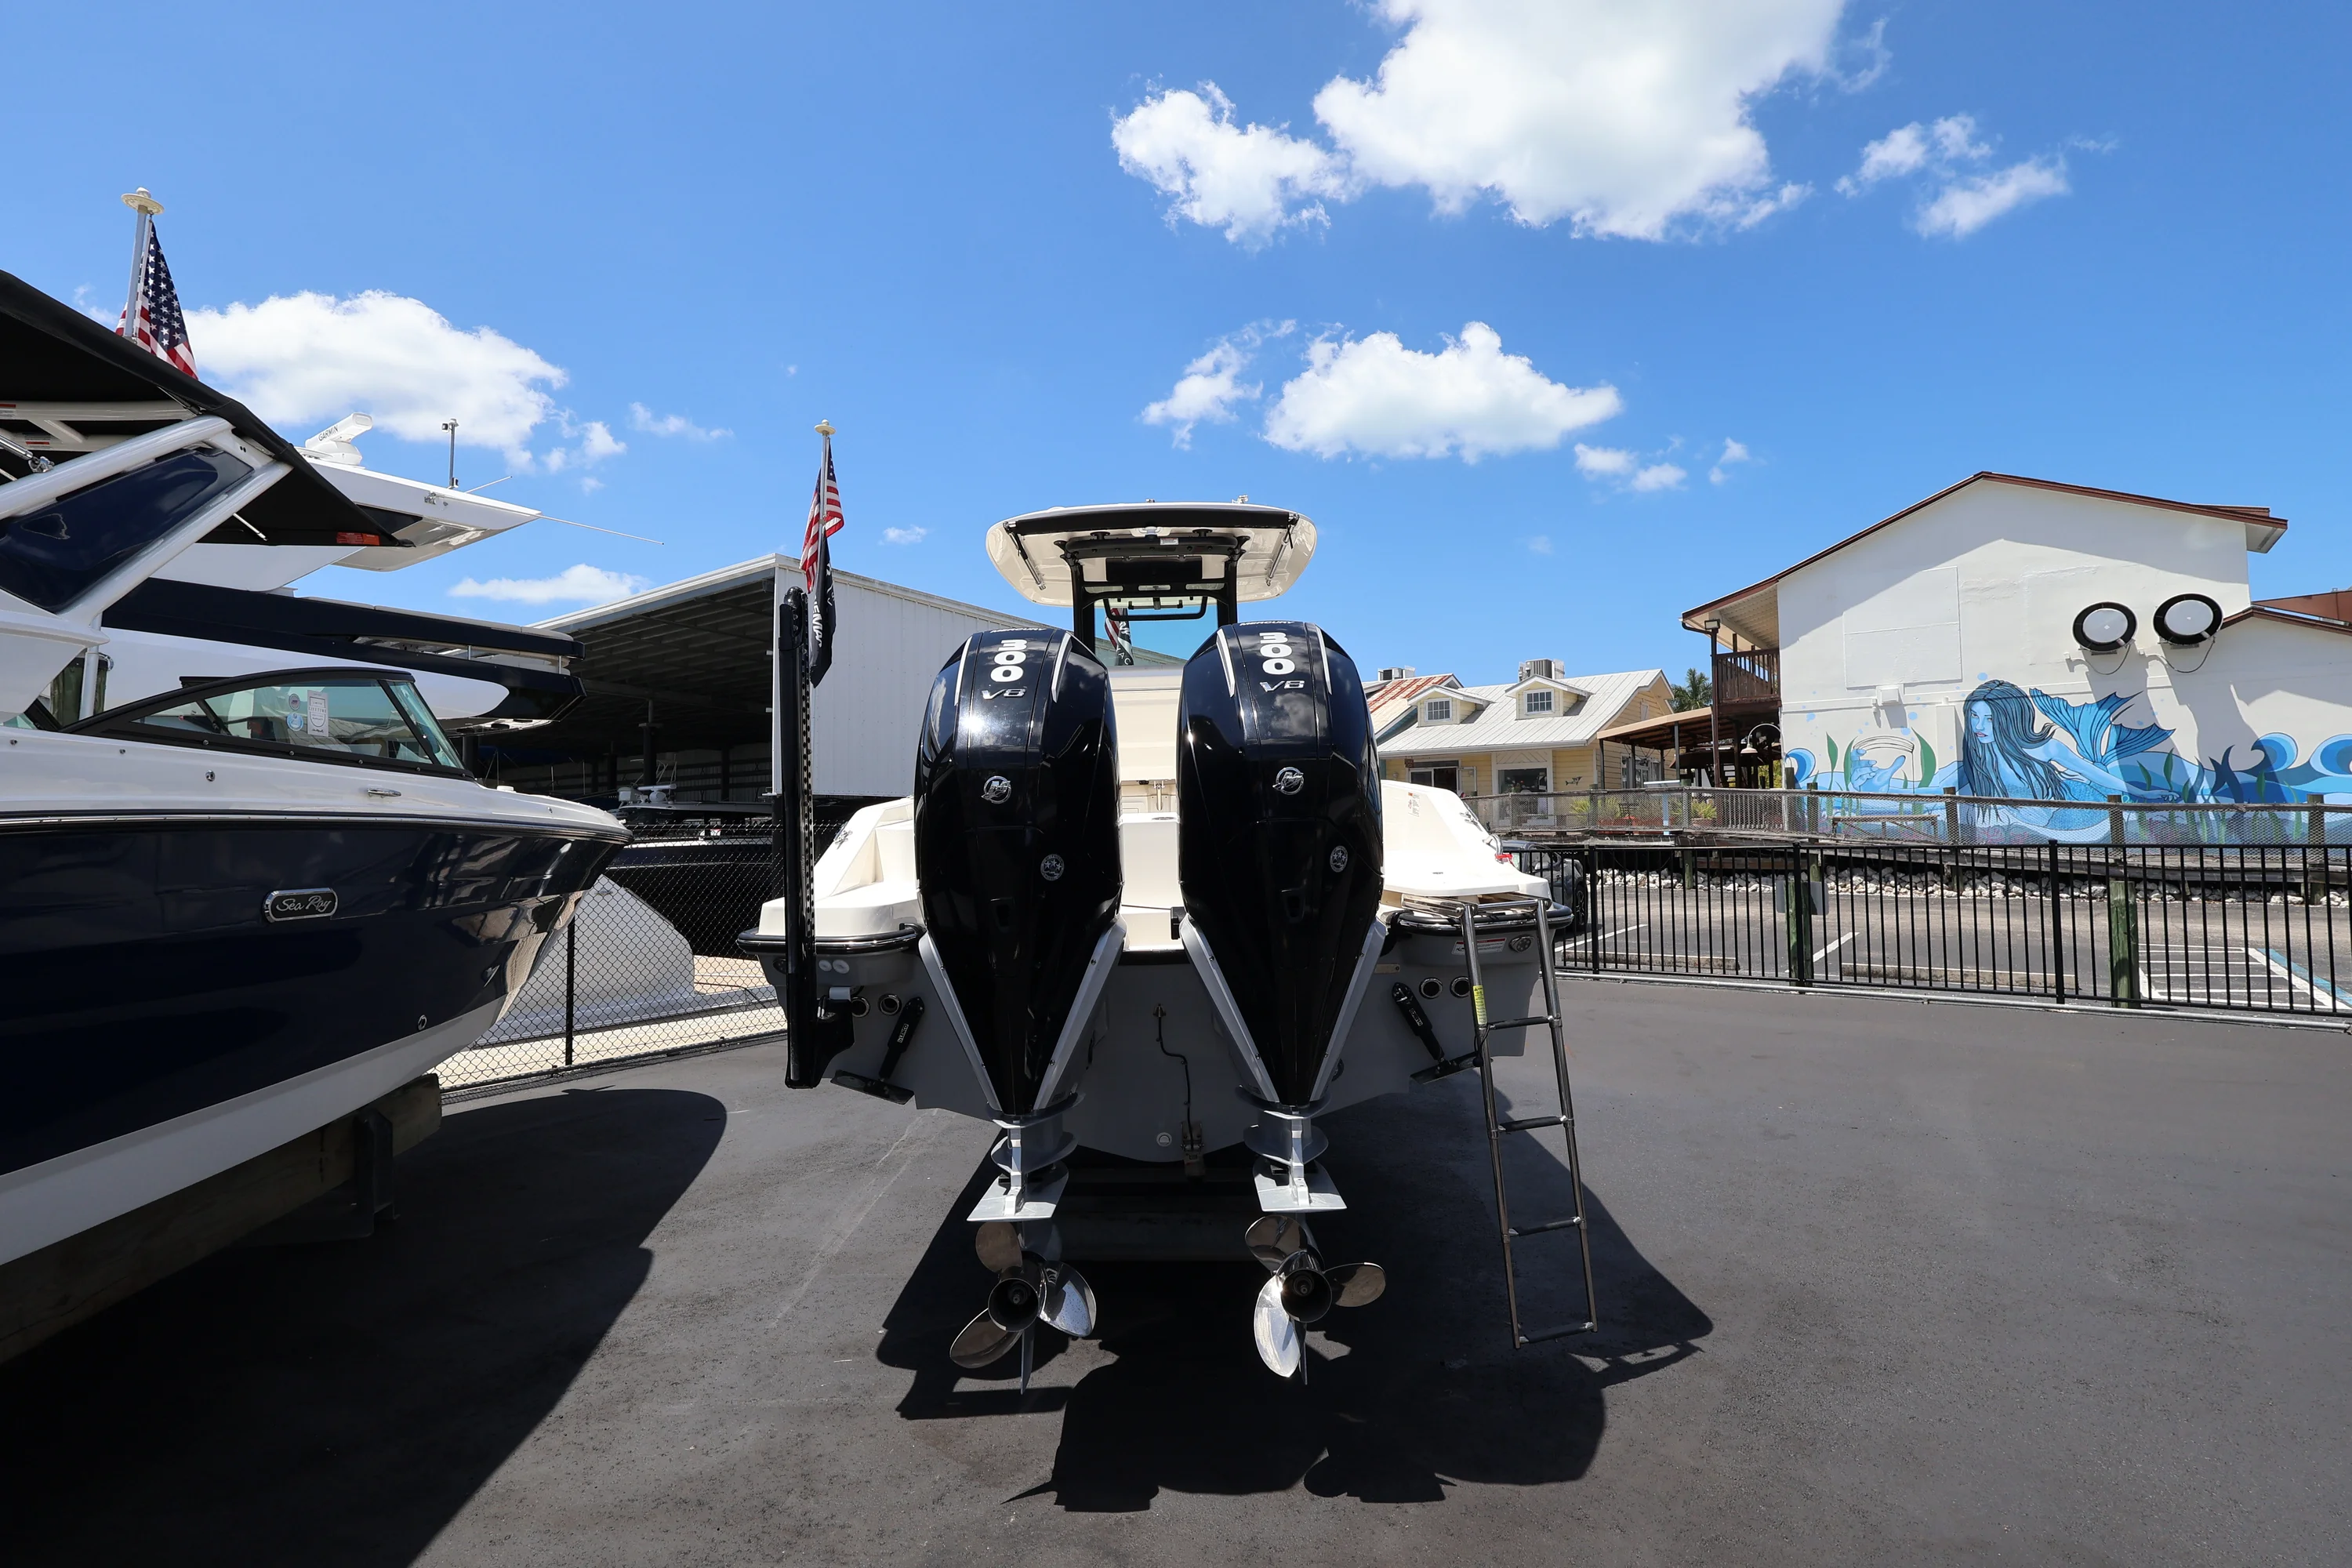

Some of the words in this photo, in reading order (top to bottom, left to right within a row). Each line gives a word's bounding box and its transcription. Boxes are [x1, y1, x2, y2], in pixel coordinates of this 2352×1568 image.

[318, 425, 339, 441] GARMIN
[990, 639, 1028, 683] 300
[1259, 632, 1295, 675] 300
[982, 688, 1026, 699] V8
[276, 898, 305, 912] Sea
[305, 895, 332, 913] Ray
